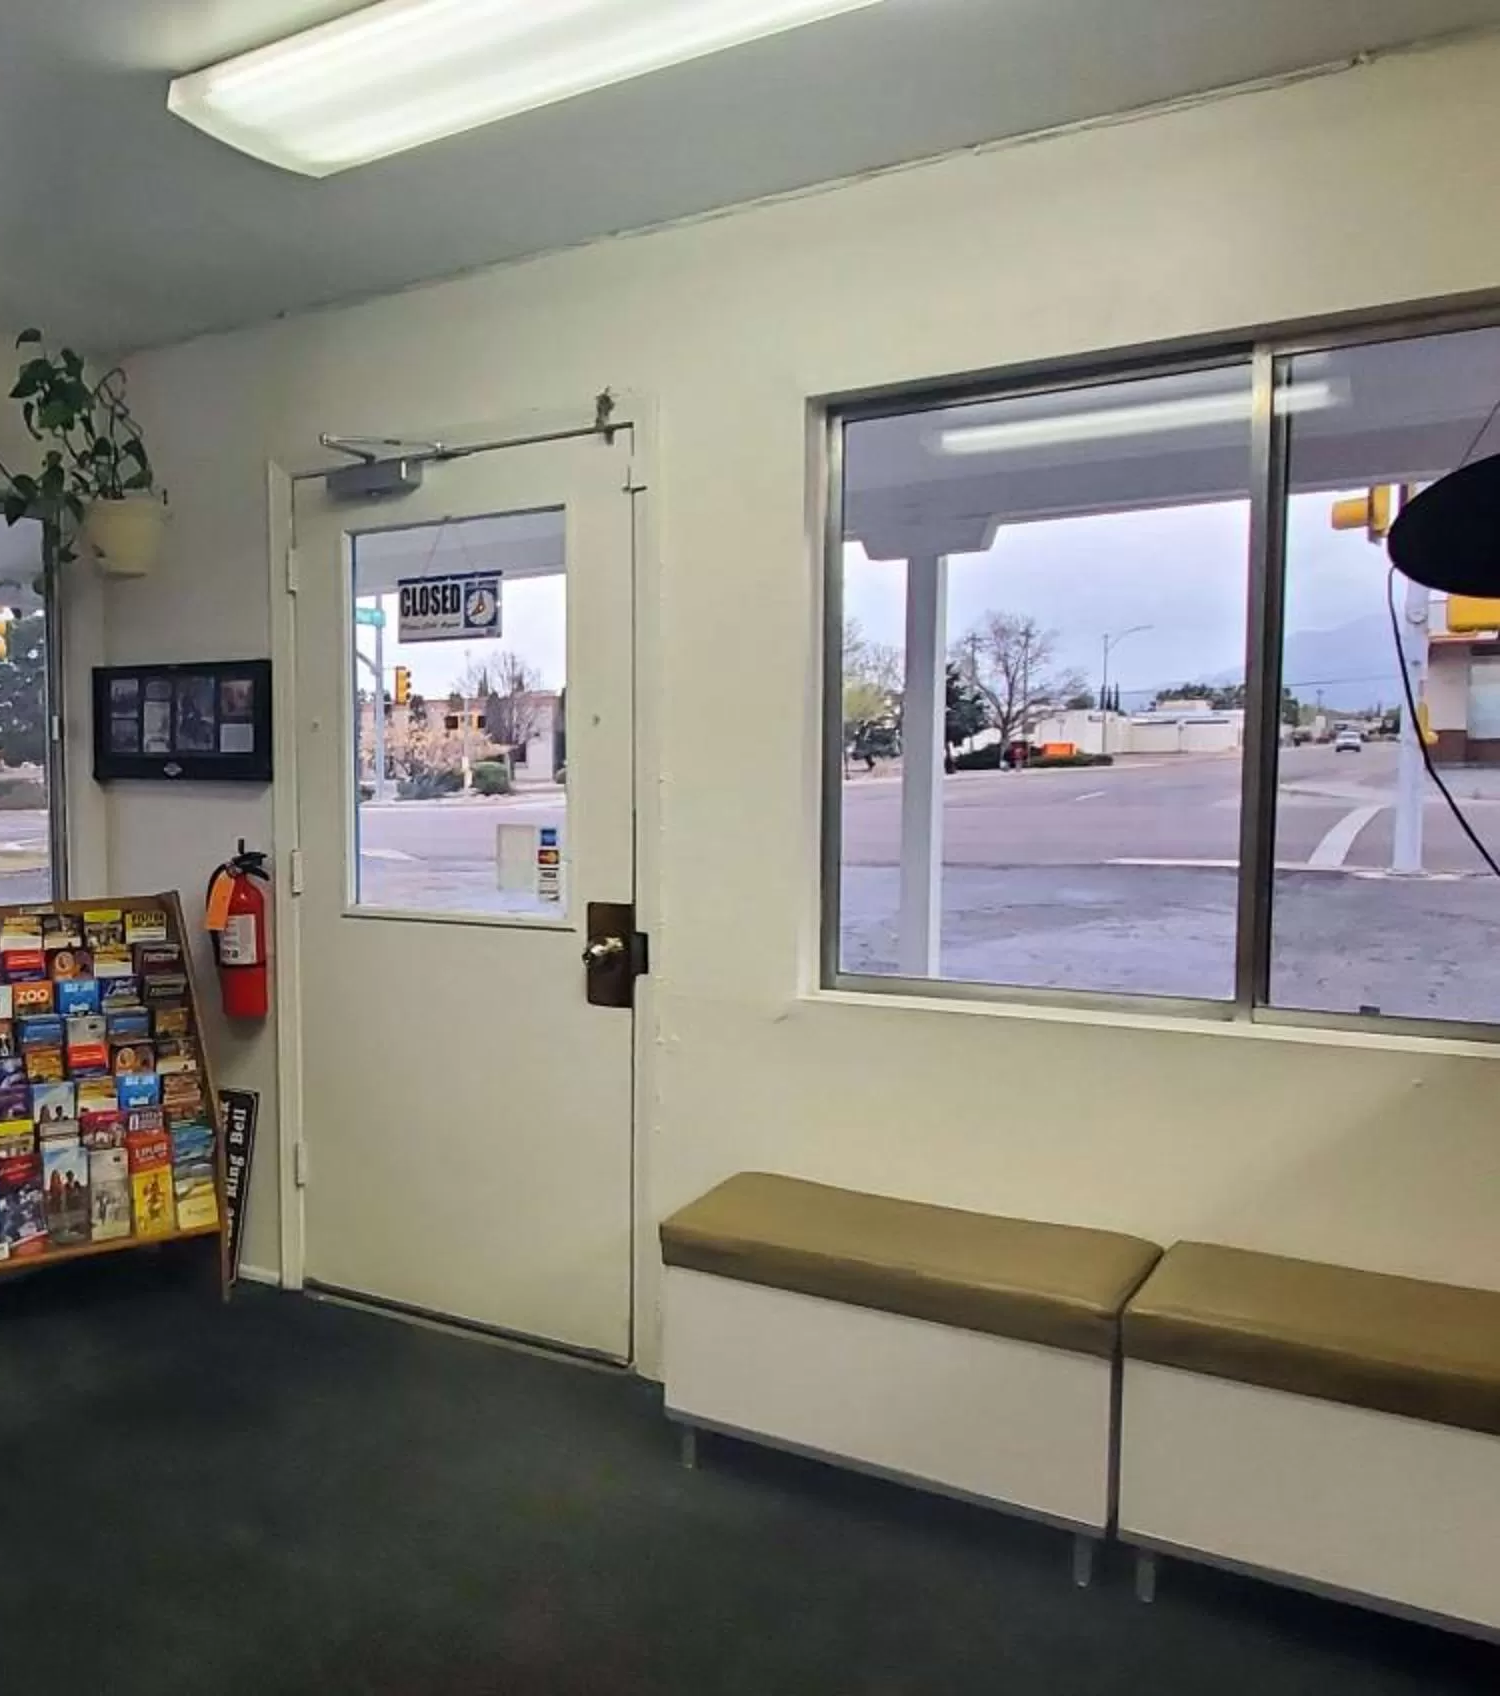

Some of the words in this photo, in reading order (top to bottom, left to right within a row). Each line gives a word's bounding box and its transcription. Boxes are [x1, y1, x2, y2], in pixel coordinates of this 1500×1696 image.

[400, 583, 461, 617] CLOSED
[18, 989, 48, 1005] ZOO
[230, 1108, 247, 1144] Bell
